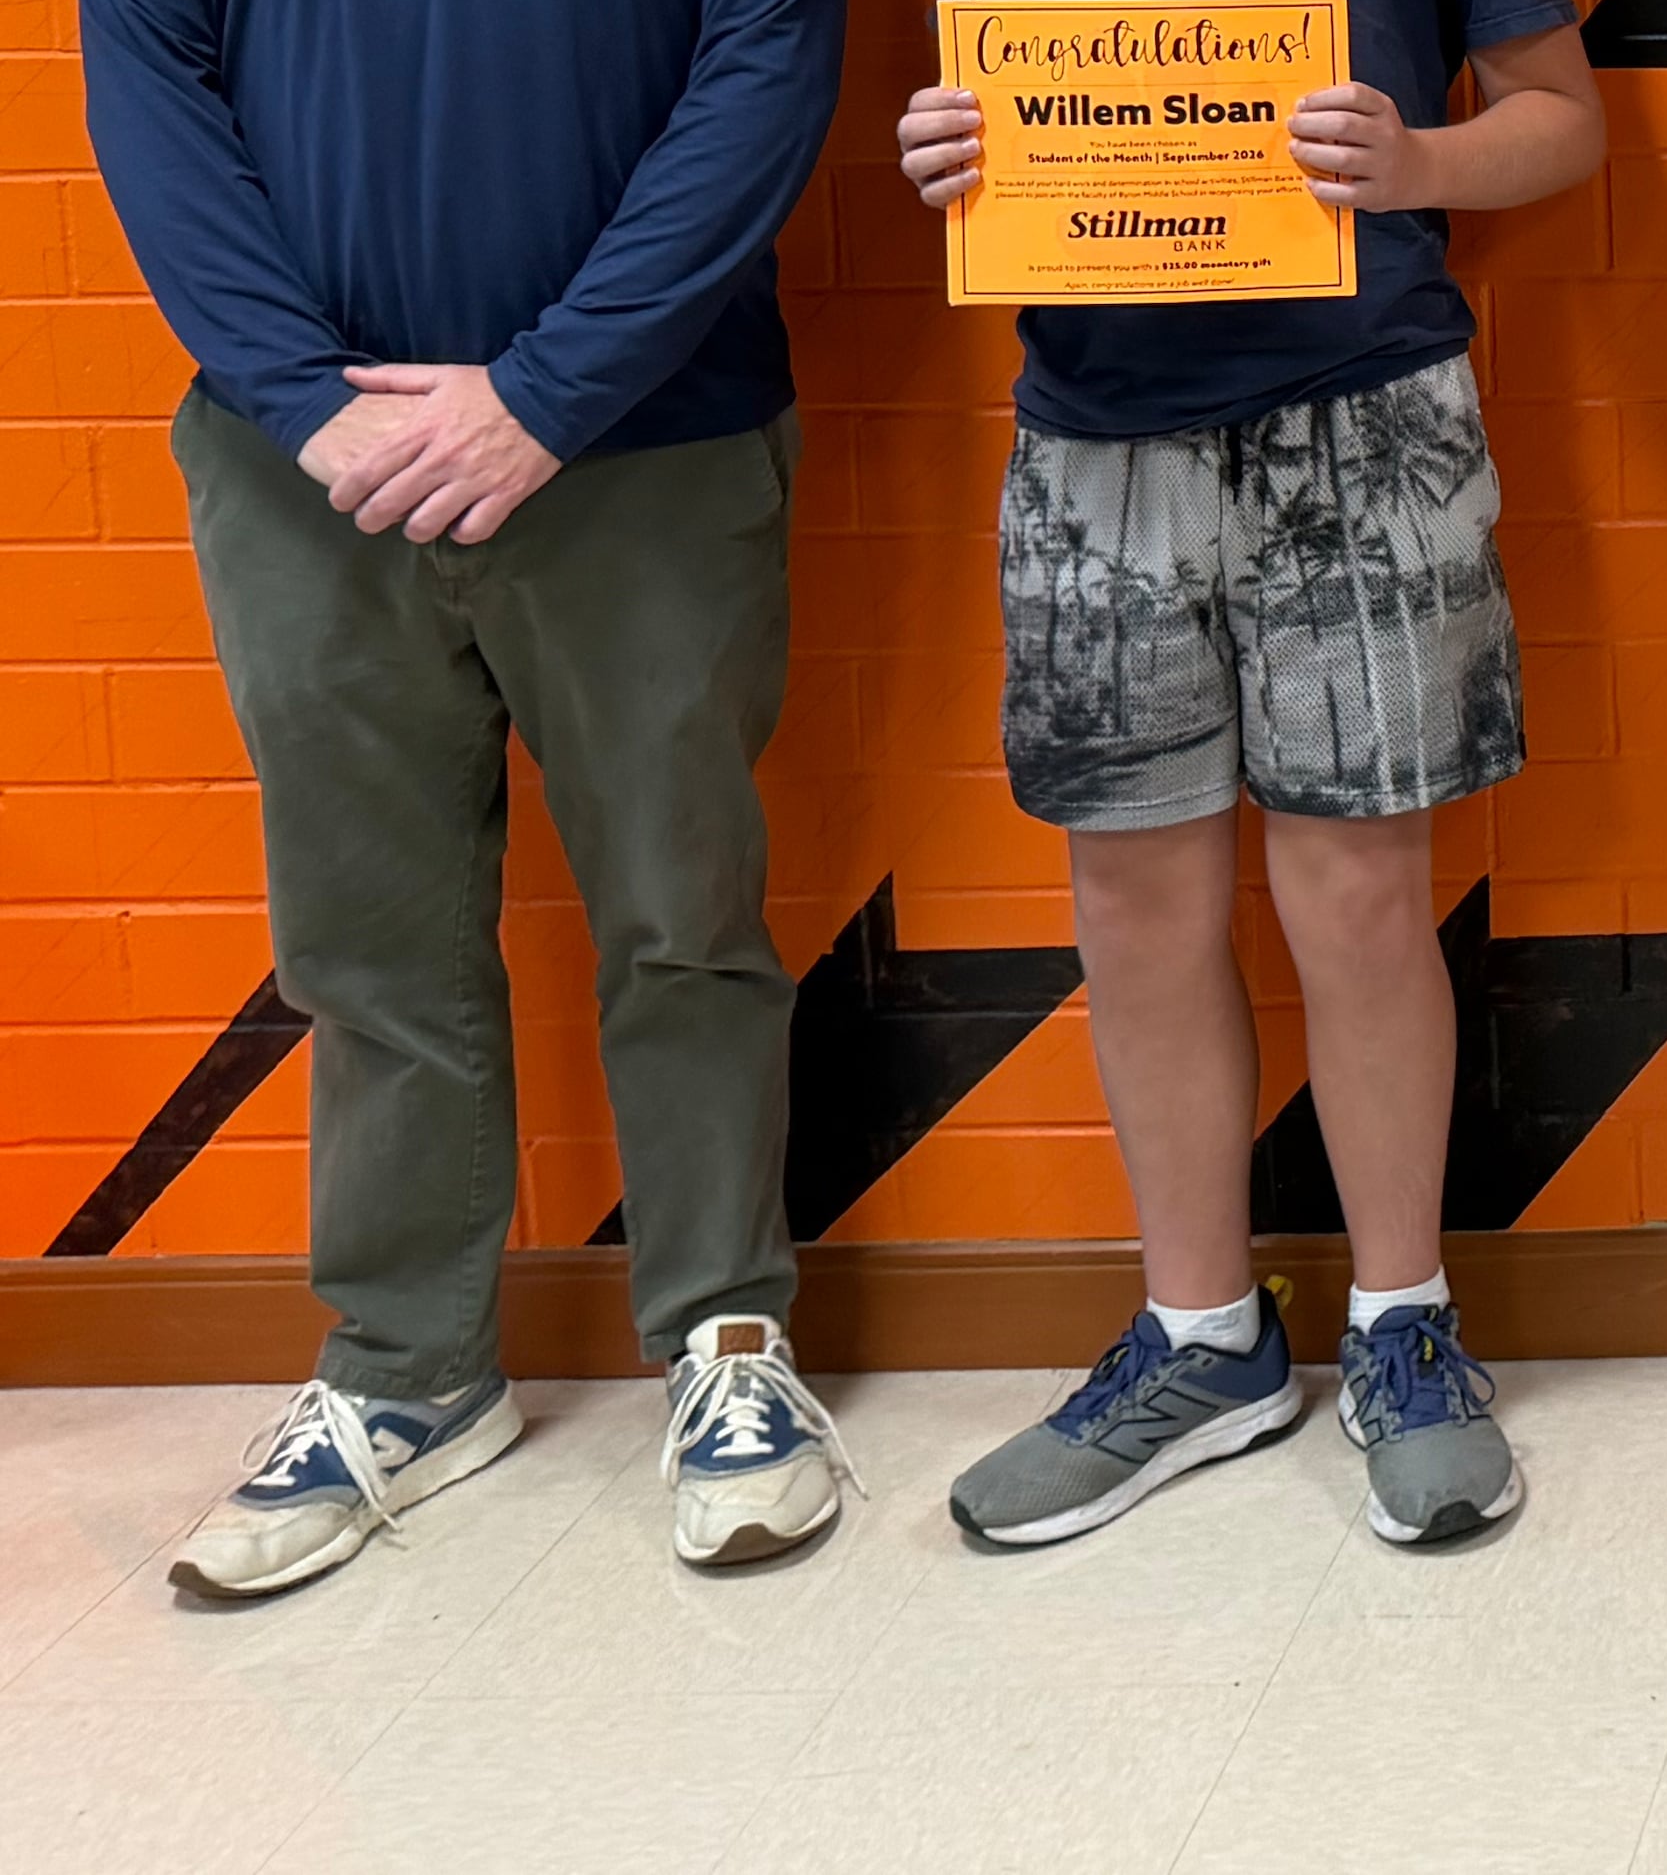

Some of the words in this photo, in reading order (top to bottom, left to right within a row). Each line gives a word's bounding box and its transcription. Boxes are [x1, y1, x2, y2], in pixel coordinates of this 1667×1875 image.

[976, 11, 1310, 82] Congratulations!
[1013, 93, 1152, 126] Willem
[1162, 92, 1275, 125] Sloan
[1027, 152, 1073, 163] Student
[1075, 152, 1088, 163] of
[1090, 152, 1110, 163] the
[1113, 151, 1152, 163] Month
[1162, 150, 1229, 164] September
[1232, 149, 1264, 160] 2026
[1067, 209, 1226, 238] Stillman
[1173, 238, 1225, 252] BANK
